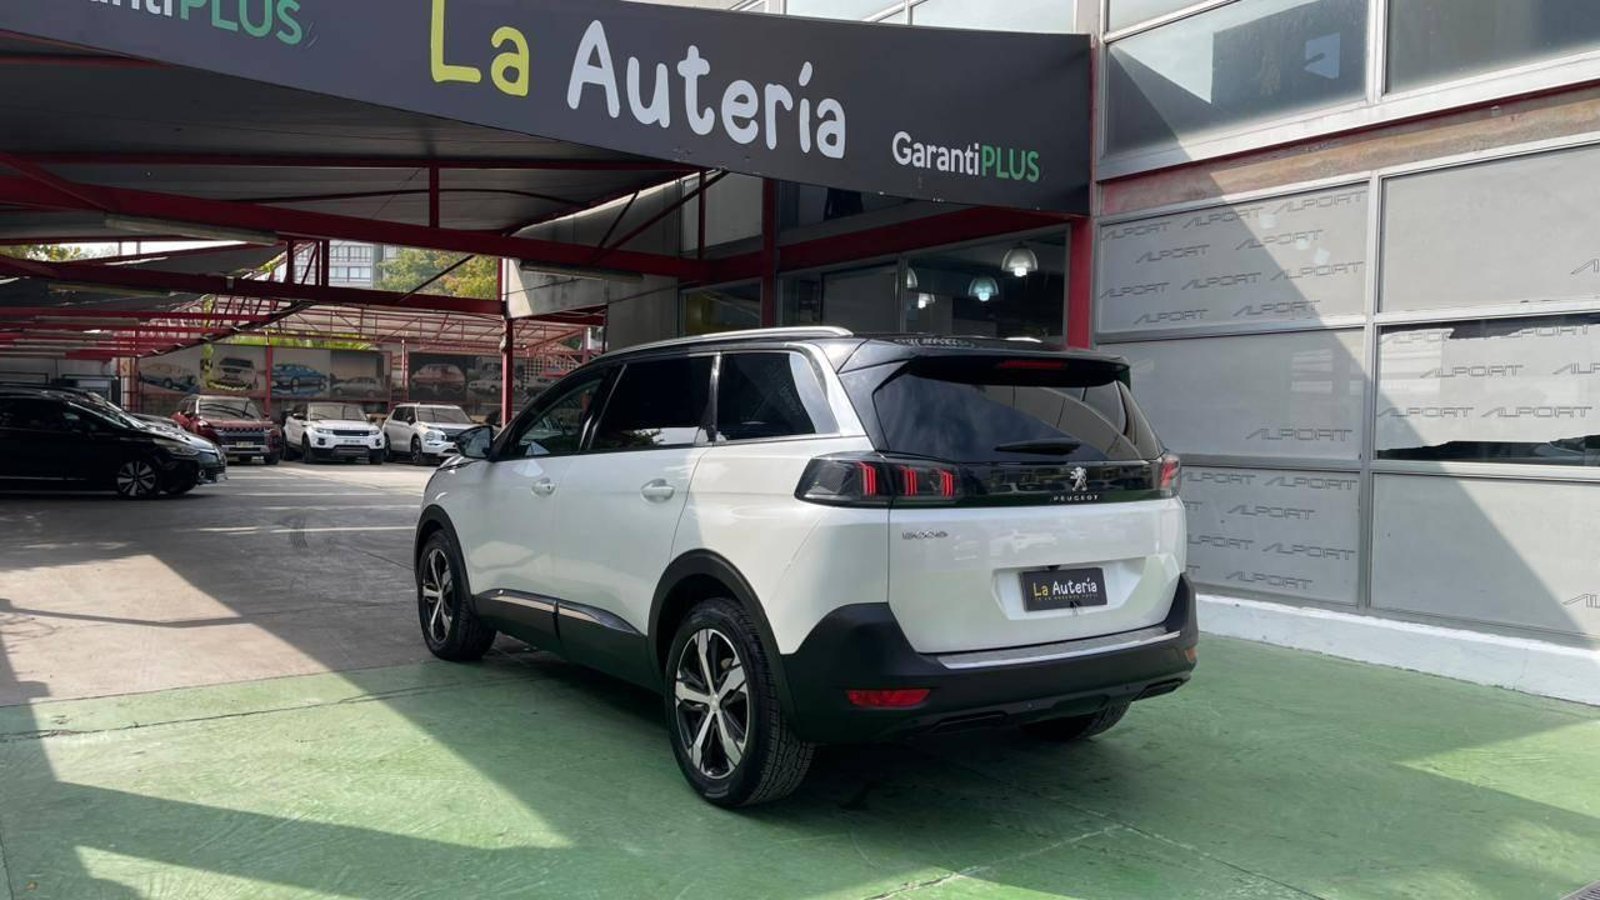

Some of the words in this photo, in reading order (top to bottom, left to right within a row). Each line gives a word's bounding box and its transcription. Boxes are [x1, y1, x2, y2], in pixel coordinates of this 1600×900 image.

[430, 0, 531, 97] La
[567, 20, 847, 160] Autería
[892, 131, 1040, 182] GarantiPLUS
[1033, 582, 1049, 597] La
[1052, 577, 1098, 596] Autería
